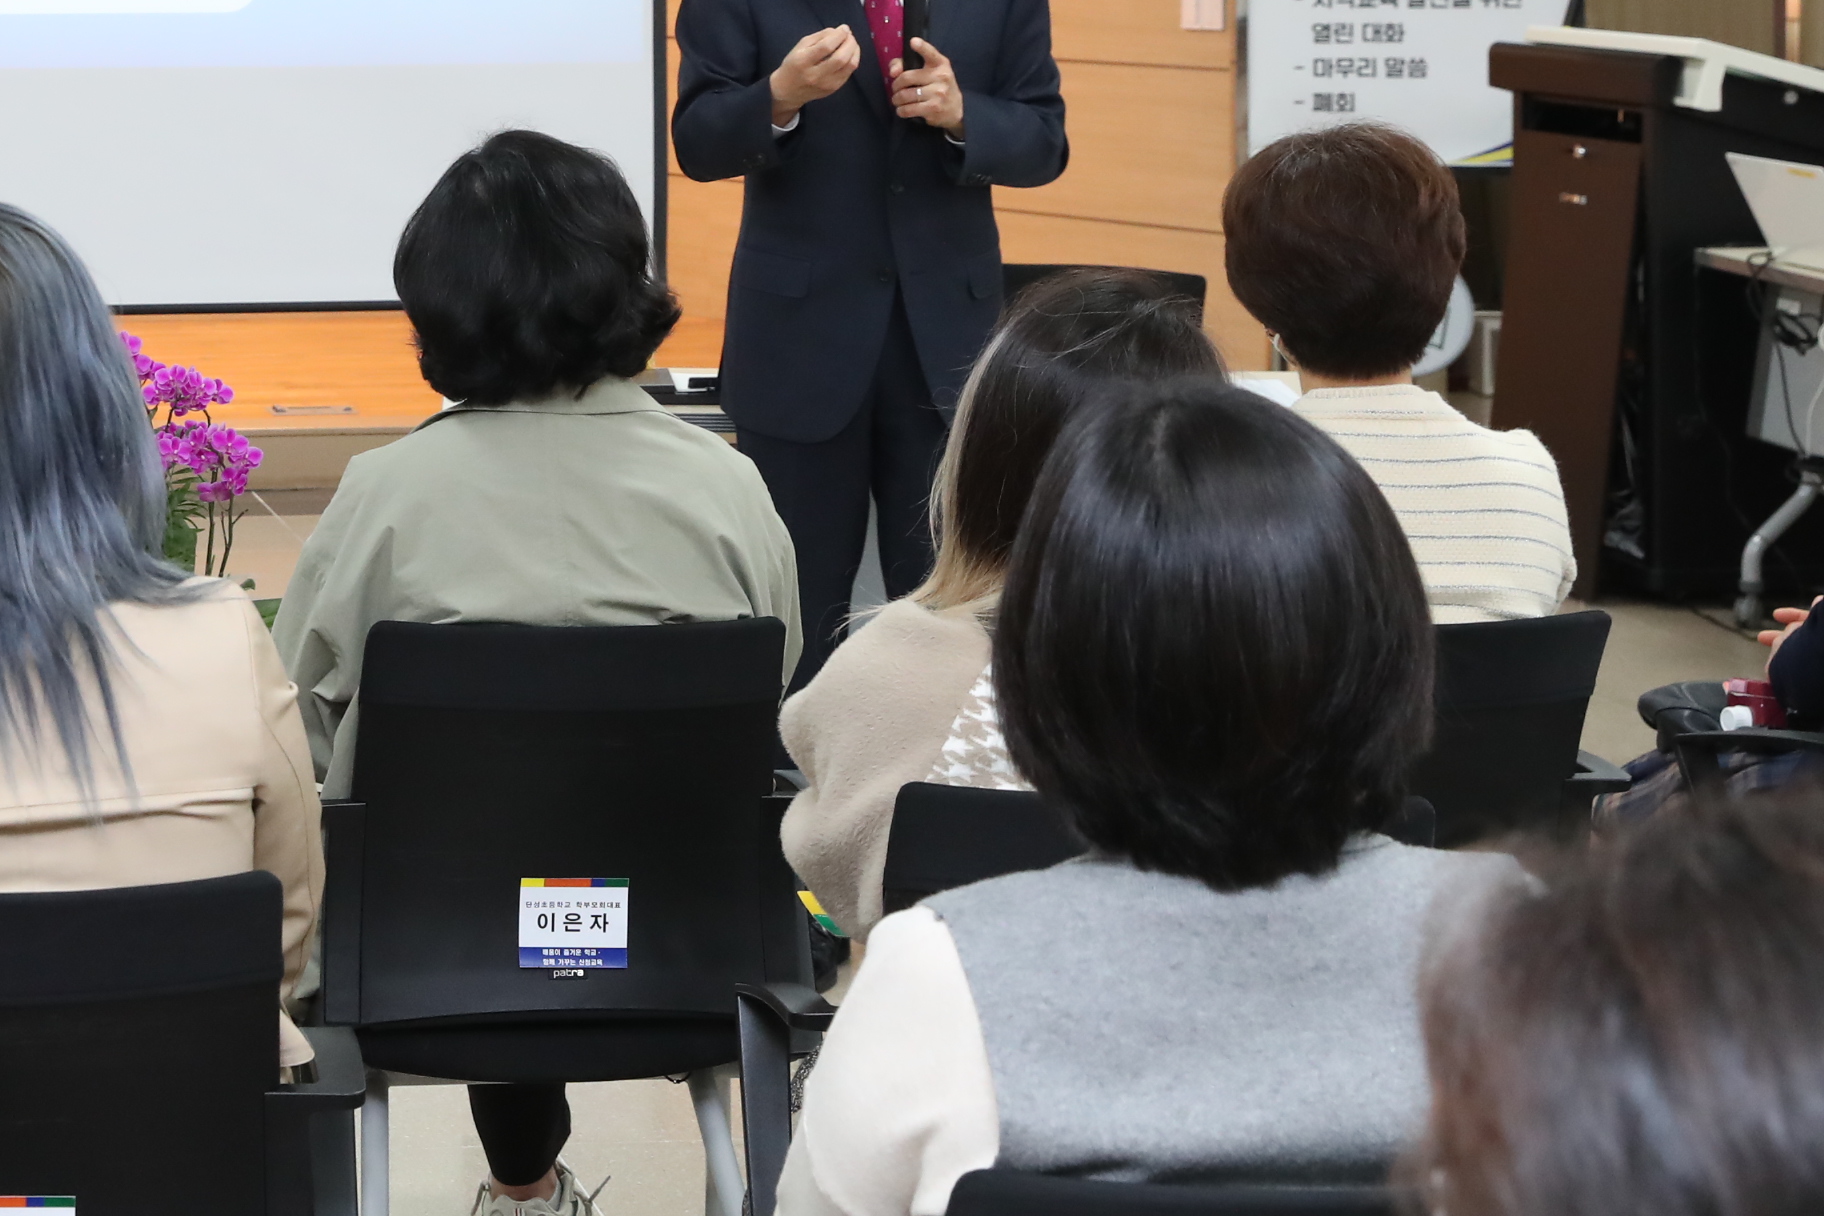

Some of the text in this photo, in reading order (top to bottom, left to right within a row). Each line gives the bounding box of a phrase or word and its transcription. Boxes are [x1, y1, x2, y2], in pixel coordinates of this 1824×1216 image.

[1312, 23, 1404, 44] 열린 대화
[1313, 57, 1427, 78] 마무리 말씀
[553, 969, 584, 979] patra
